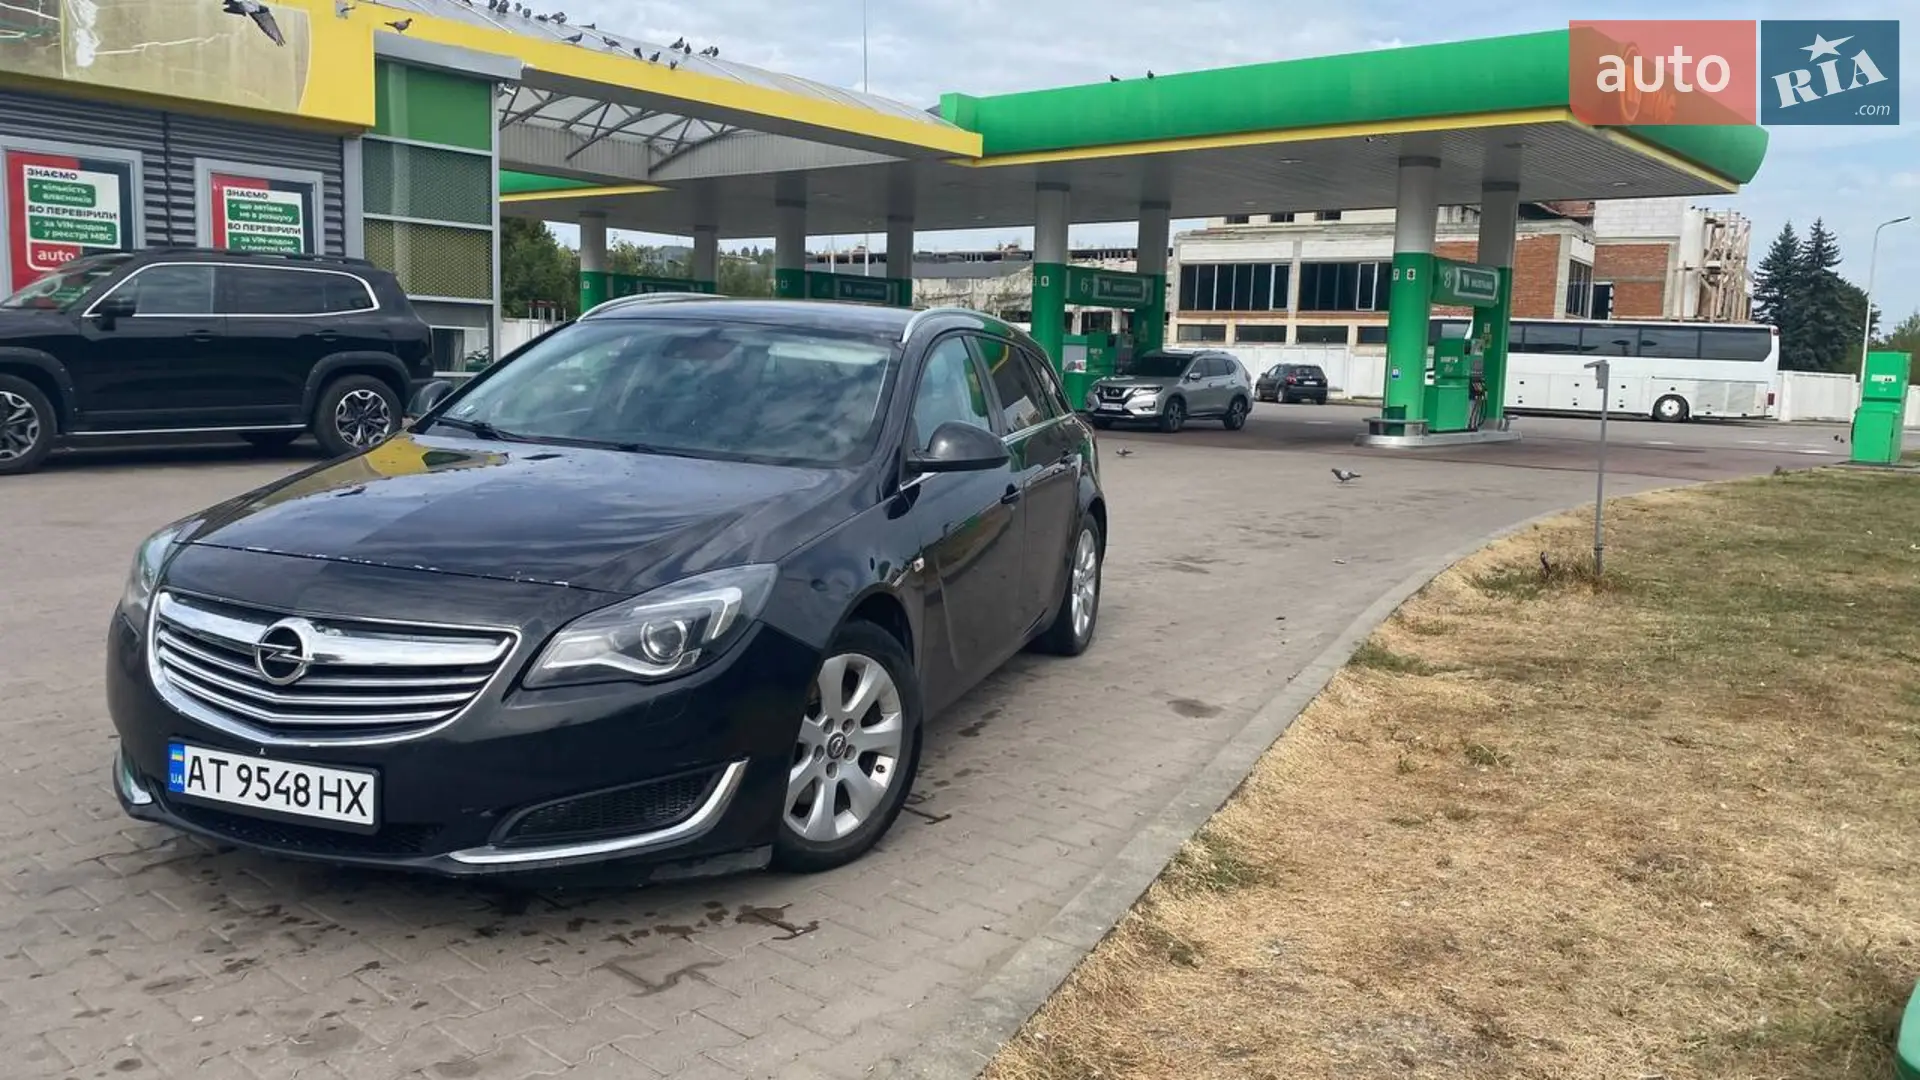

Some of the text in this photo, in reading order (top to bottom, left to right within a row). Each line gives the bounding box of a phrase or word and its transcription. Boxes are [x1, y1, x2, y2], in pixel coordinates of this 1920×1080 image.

[27, 168, 78, 180] ЗНАЄМО
[42, 183, 88, 194] кількість
[226, 189, 269, 199] ЗНАЄМО
[28, 205, 118, 219] БО ПЕРЕВІРИЛИ
[44, 219, 108, 232] за VIN-кодом
[227, 223, 302, 234] БО ПЕРЕВІРИЛИ
[90, 232, 112, 242] МВС
[37, 249, 75, 262] auto
[171, 773, 184, 785] UA
[187, 755, 368, 817] AT 9548 HX
